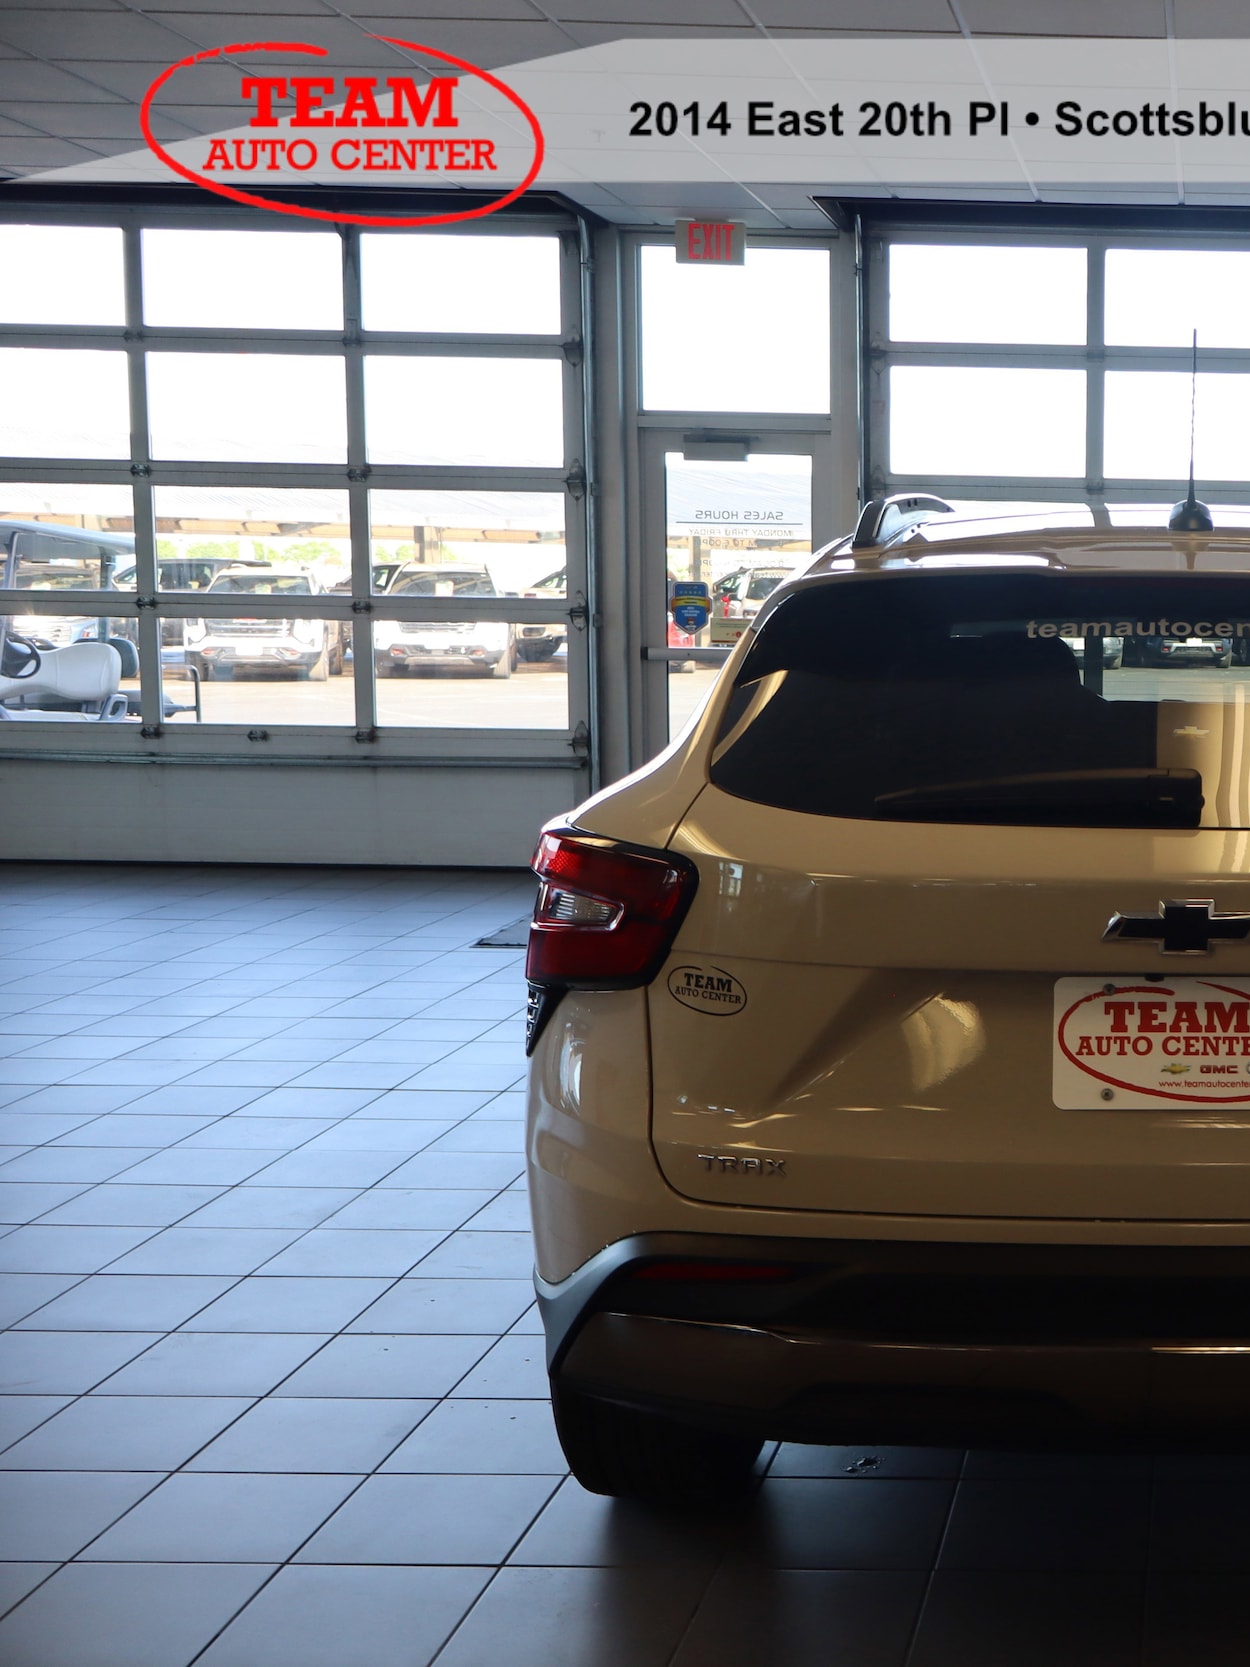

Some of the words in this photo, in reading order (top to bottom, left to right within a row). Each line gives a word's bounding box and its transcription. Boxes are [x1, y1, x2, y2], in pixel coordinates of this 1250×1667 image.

[688, 223, 735, 262] EXIT
[684, 972, 732, 993] TEAM
[674, 986, 699, 998] AUTO
[701, 990, 742, 1004] CENTER
[1104, 1002, 1250, 1033] TEAM
[1075, 1036, 1153, 1056] AUTO
[1200, 1064, 1239, 1074] GMC
[697, 1153, 787, 1177] TRAX
